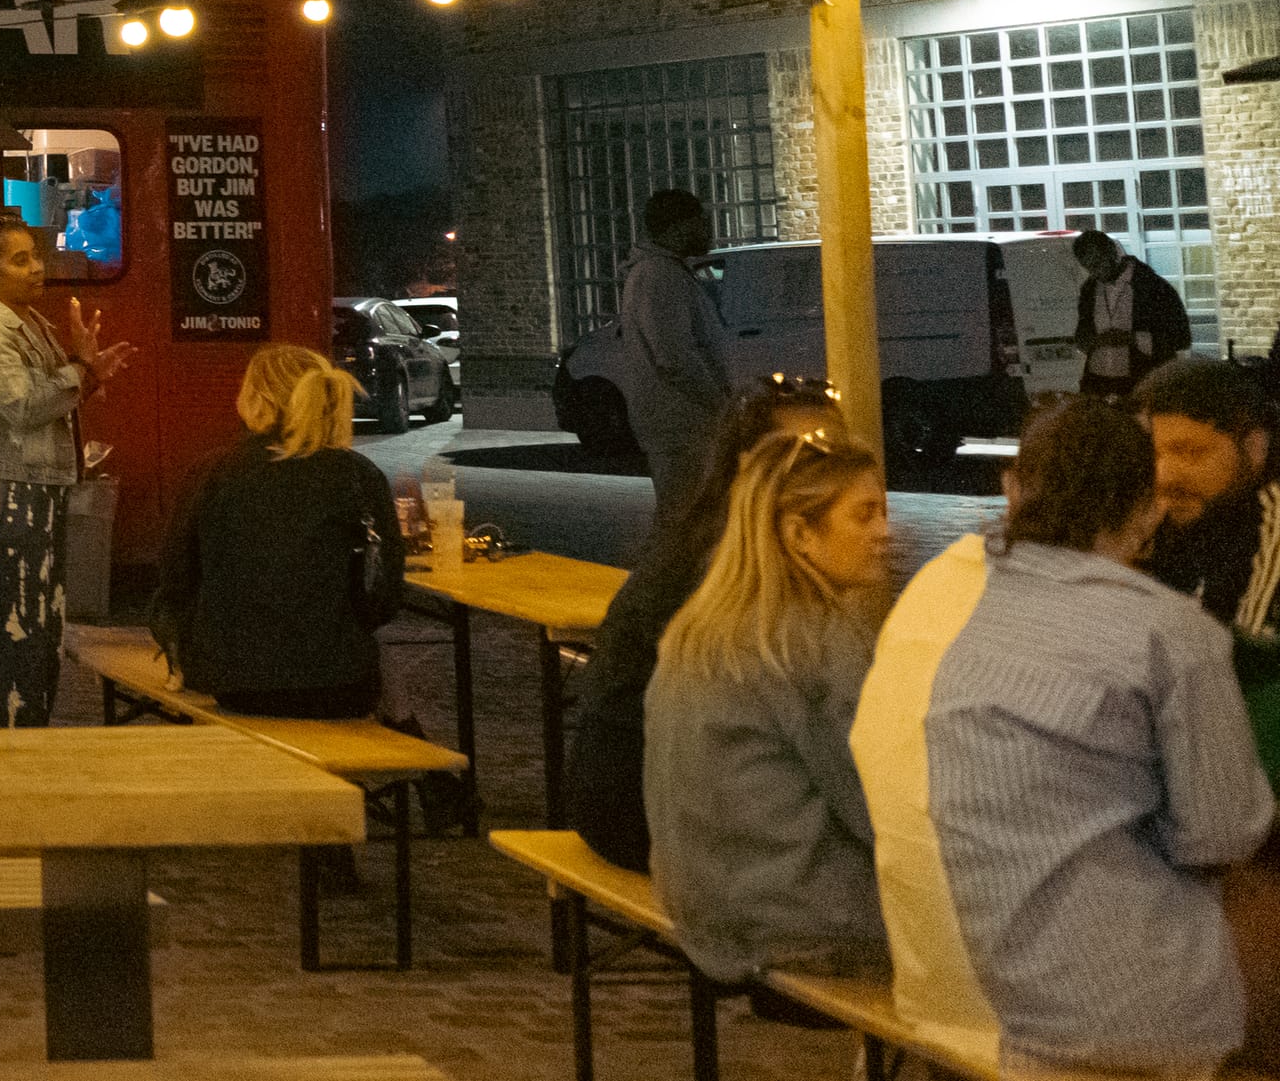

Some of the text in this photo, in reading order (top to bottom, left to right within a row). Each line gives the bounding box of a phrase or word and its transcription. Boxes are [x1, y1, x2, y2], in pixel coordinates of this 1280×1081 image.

[217, 135, 260, 153] HAD
[171, 156, 259, 177] GORDON,
[176, 178, 256, 196] BUT JIM
[194, 200, 241, 218] WAS
[173, 222, 262, 239] BETTER!"
